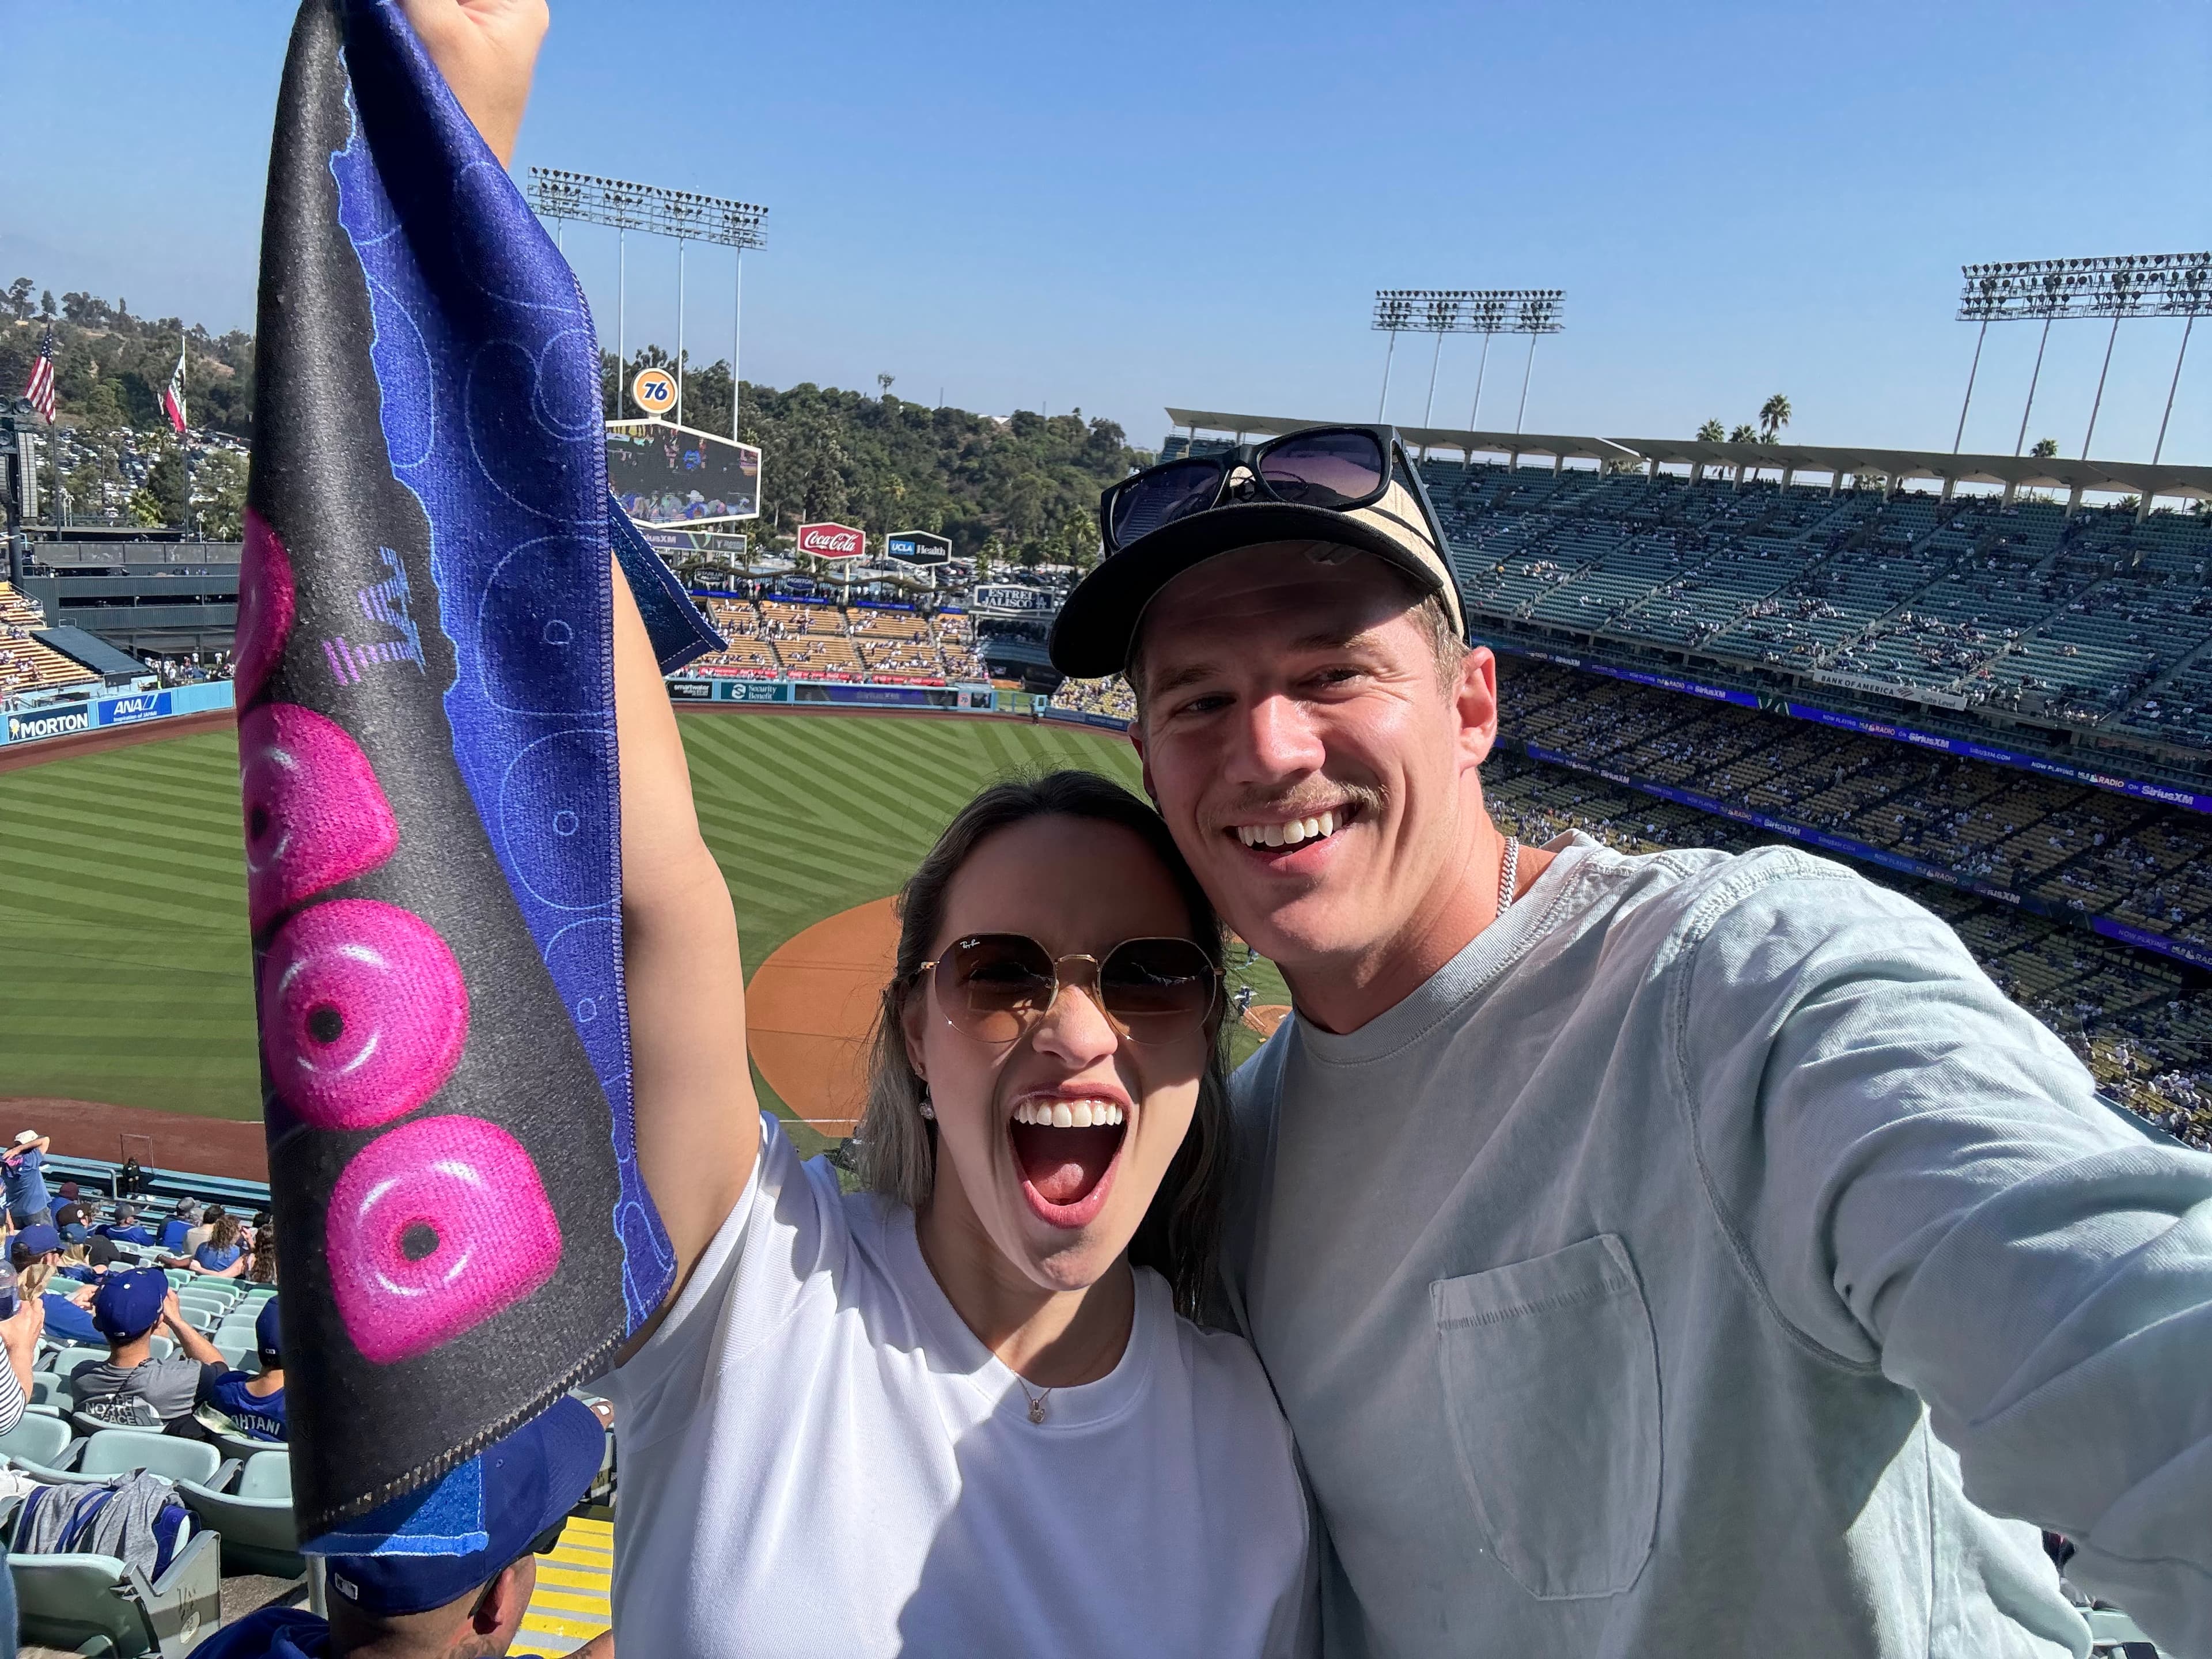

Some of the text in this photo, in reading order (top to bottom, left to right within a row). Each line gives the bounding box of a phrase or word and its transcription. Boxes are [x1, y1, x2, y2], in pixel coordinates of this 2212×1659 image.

[643, 382, 668, 401] 76
[646, 534, 677, 543] iusXM
[804, 531, 859, 552] Coca-Cola
[891, 543, 946, 556] UCLA Health
[982, 597, 1033, 608] JALISCO
[749, 684, 777, 695] Security
[1695, 685, 1726, 698] SiriusXM
[1821, 676, 1843, 685] BANK
[1857, 683, 1893, 695] AMERICA
[749, 691, 772, 700] Benefit
[1921, 695, 1956, 708] Suite Level
[113, 699, 142, 715] ANA
[21, 713, 88, 738] MORTON
[1875, 725, 1895, 736] RADIO
[1908, 733, 1950, 749] SiriusXM
[2031, 762, 2047, 770] NOW
[2048, 765, 2074, 776] PLAYING
[2099, 776, 2124, 787] RADIO
[2142, 785, 2194, 805] SiriusXM
[1764, 818, 1801, 836] SiriusXM
[1935, 872, 1958, 884] RADIO
[2118, 929, 2136, 940] NOW
[2137, 935, 2167, 949] PLAYING
[105, 1394, 132, 1407] THE
[85, 1402, 134, 1416] NORTH
[101, 1414, 137, 1425] FACE
